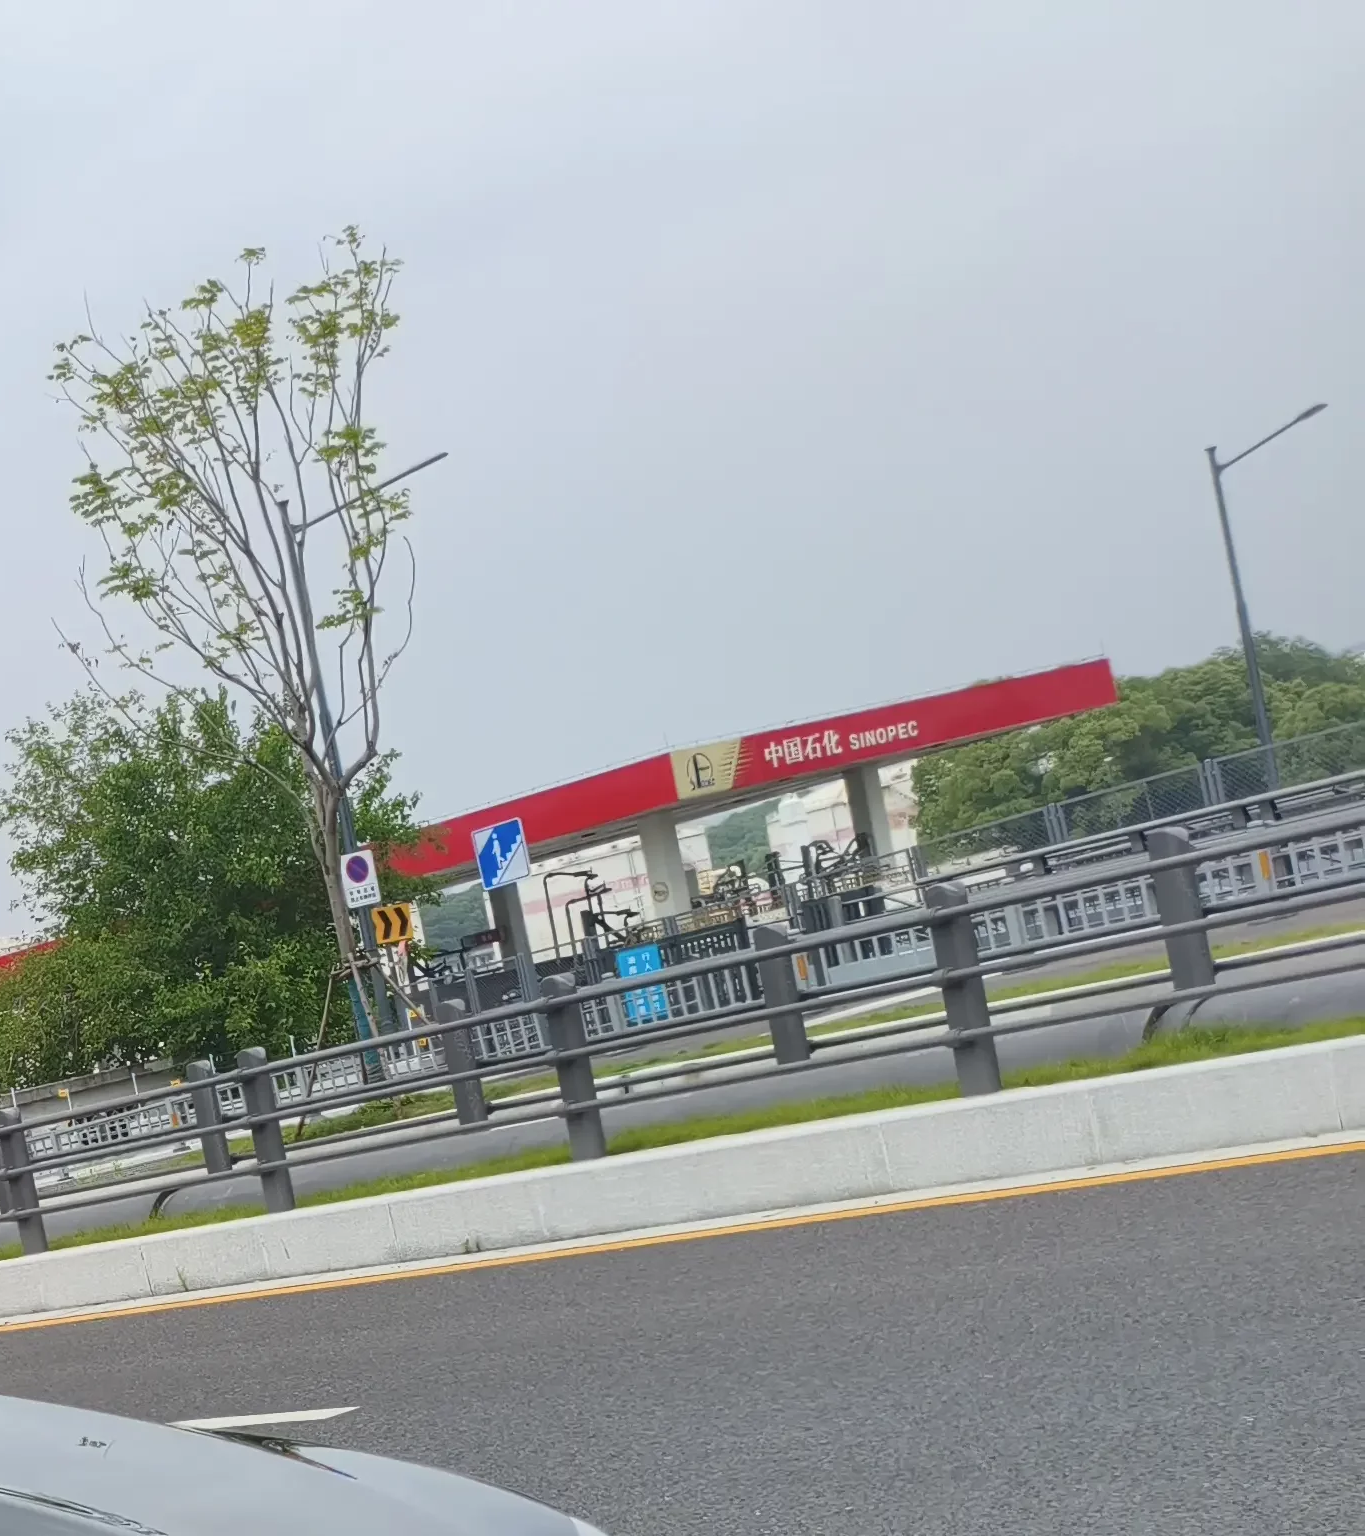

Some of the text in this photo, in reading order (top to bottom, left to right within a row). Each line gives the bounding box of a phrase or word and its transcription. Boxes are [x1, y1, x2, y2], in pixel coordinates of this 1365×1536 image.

[764, 720, 919, 768] 中国石化 SINOPEC
